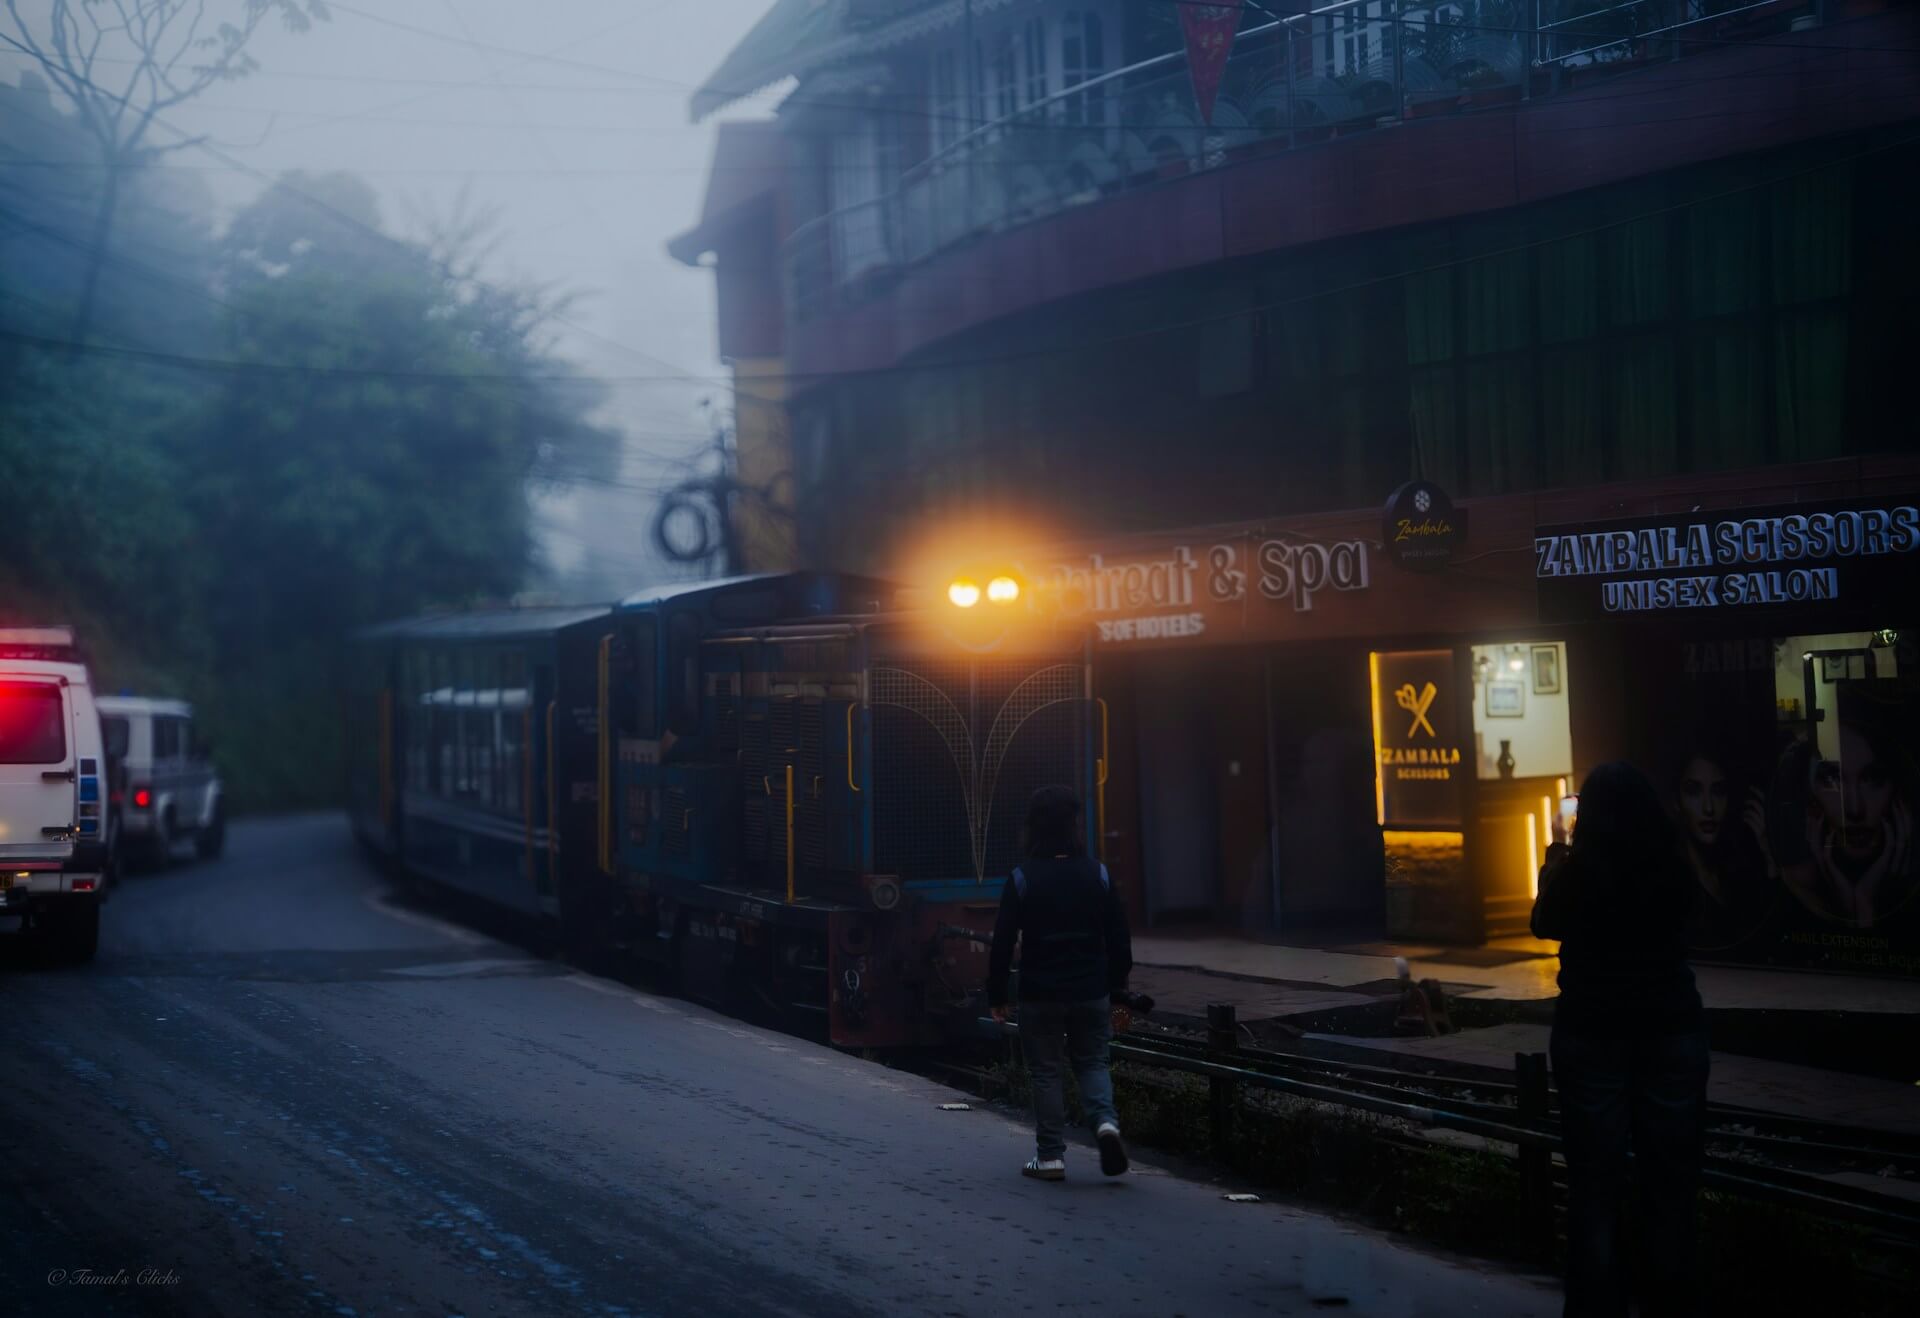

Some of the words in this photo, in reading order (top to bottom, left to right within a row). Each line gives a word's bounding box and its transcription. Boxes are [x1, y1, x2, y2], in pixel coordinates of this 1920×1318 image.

[1393, 518, 1453, 542] Zambala
[1536, 524, 1713, 578] ZAMBALA
[1715, 506, 1919, 564] SCISSORS
[1208, 545, 1247, 602] &
[1602, 575, 1719, 612] UNISEX
[1721, 568, 1839, 607] SALON
[1382, 747, 1461, 764] ZAMBALA
[1397, 767, 1450, 780] SCISSORS
[1822, 932, 1889, 950] EXTENSION
